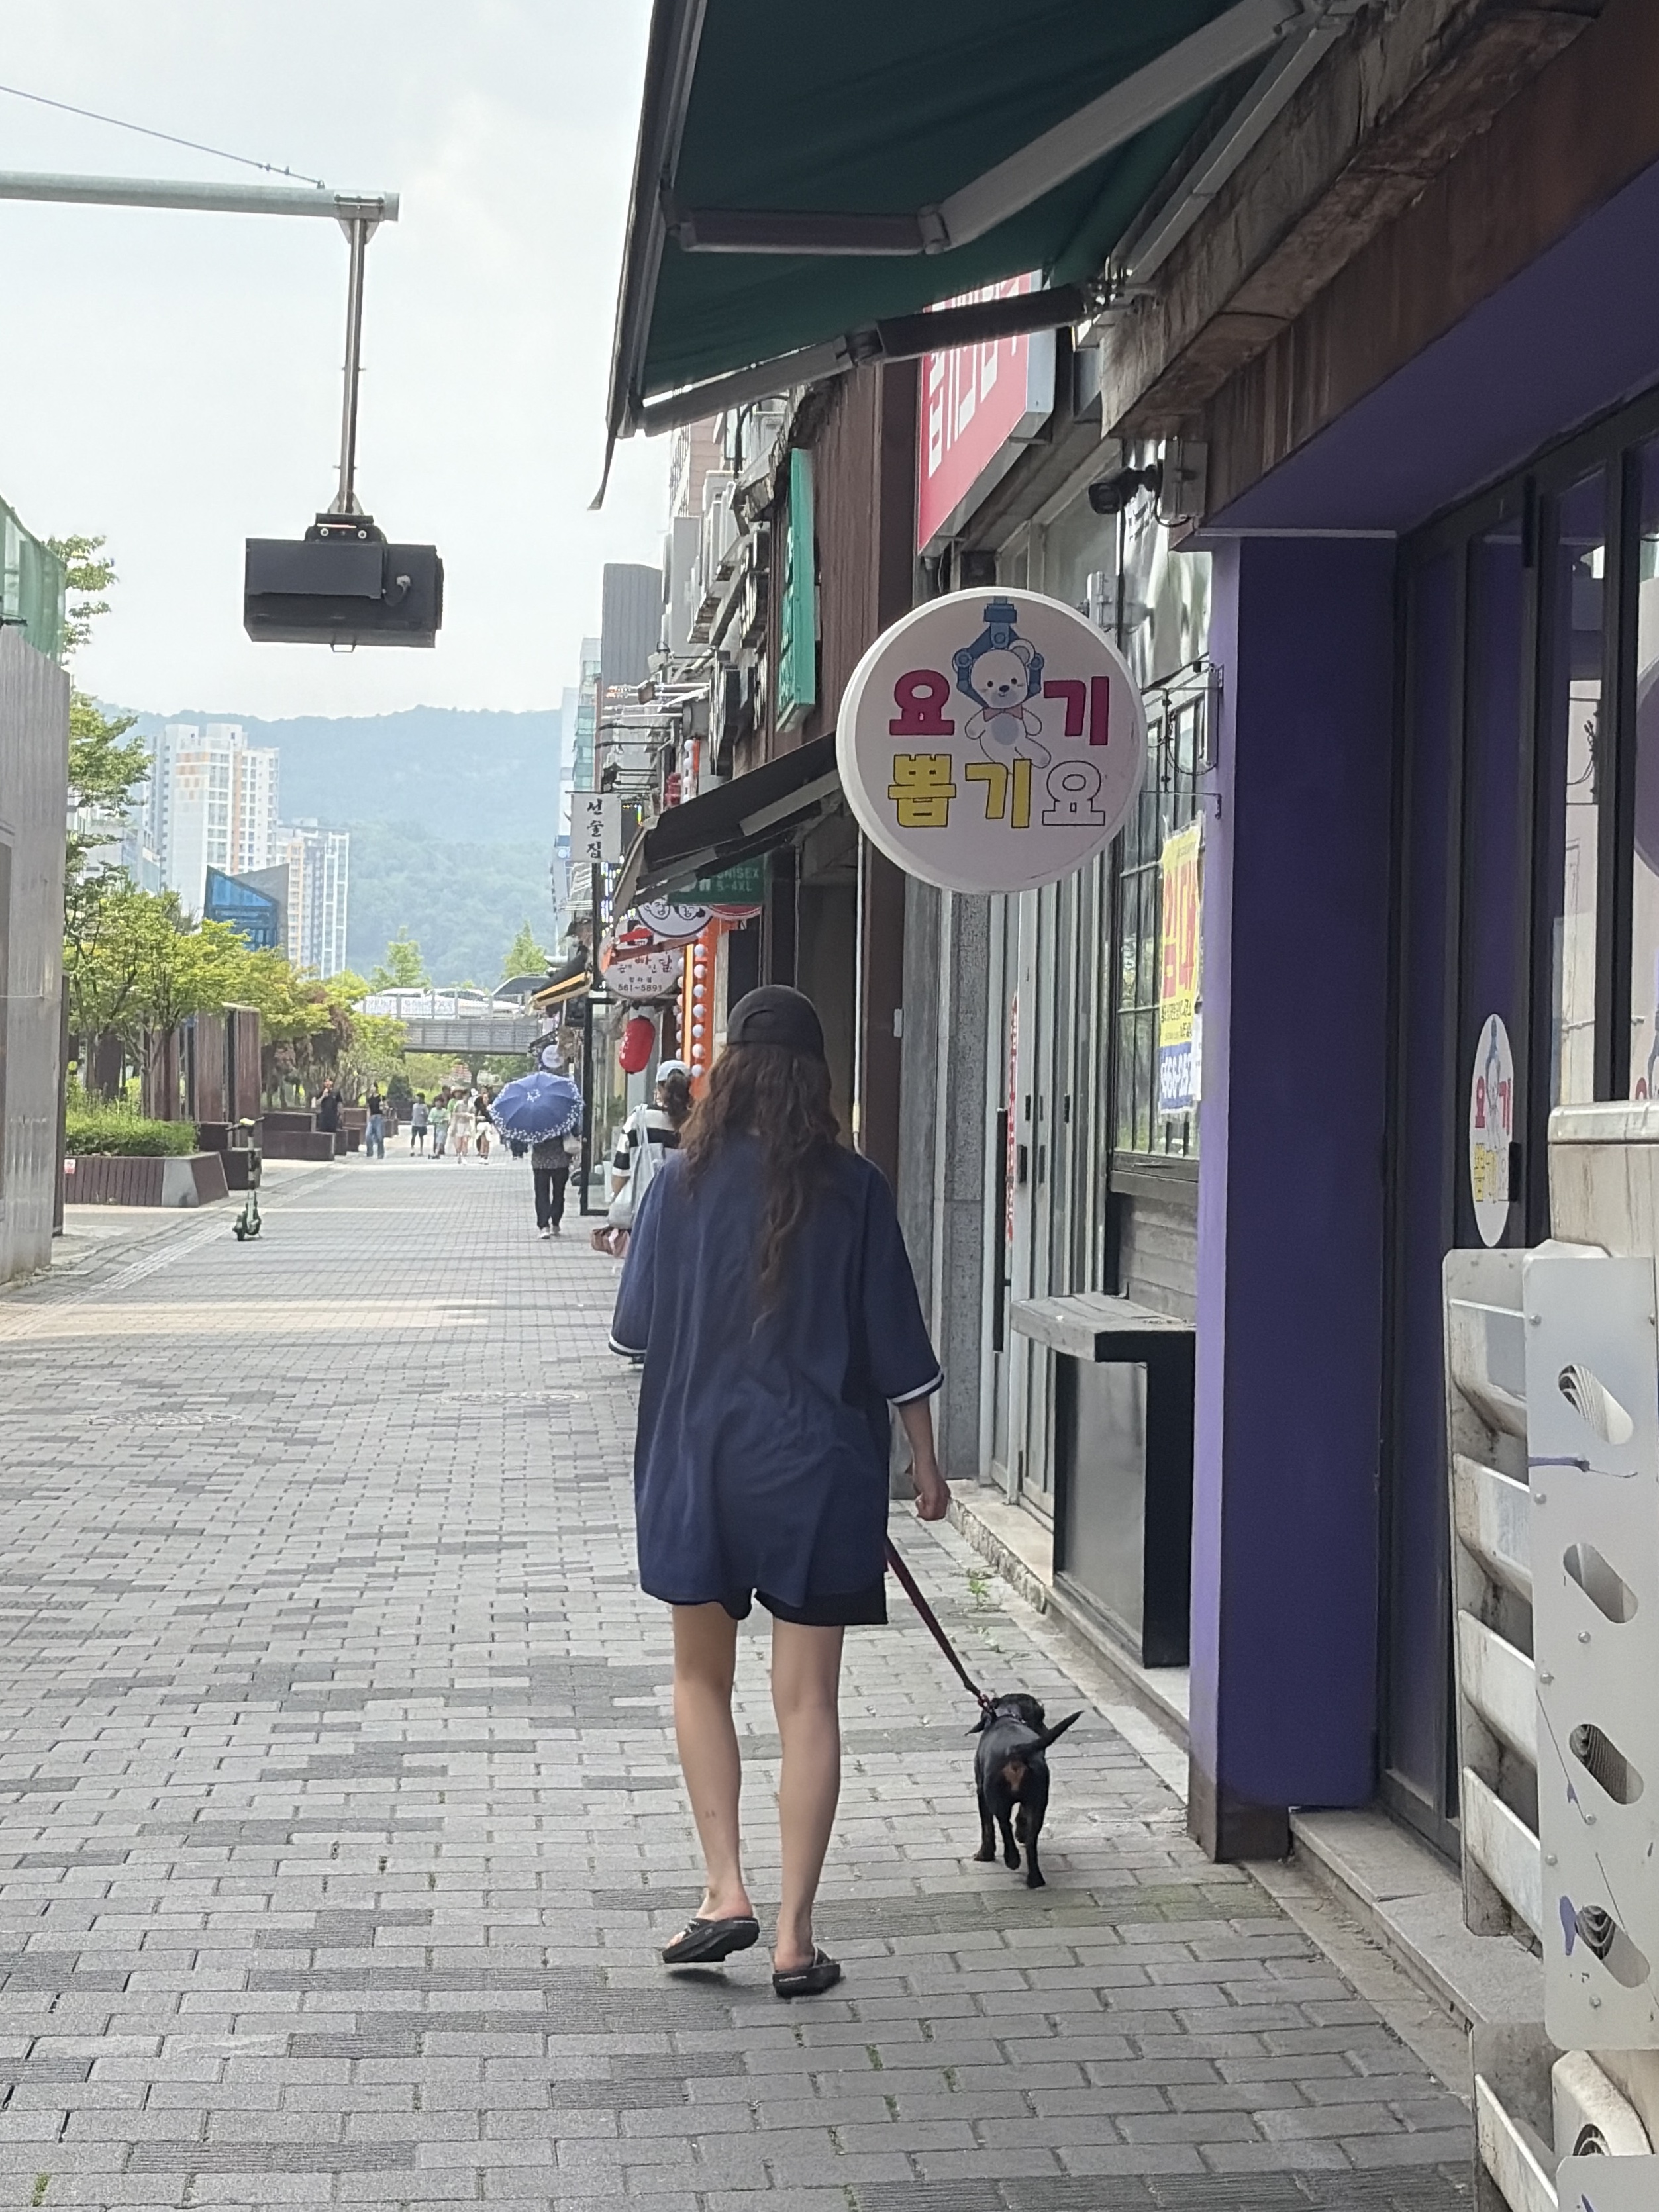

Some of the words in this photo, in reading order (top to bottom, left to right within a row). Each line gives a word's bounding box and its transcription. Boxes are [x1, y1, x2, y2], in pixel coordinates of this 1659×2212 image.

[889, 669, 1110, 747] 요기
[586, 798, 604, 859] 선술집
[887, 753, 1106, 829] 뽑기요
[1164, 861, 1196, 998] 임대
